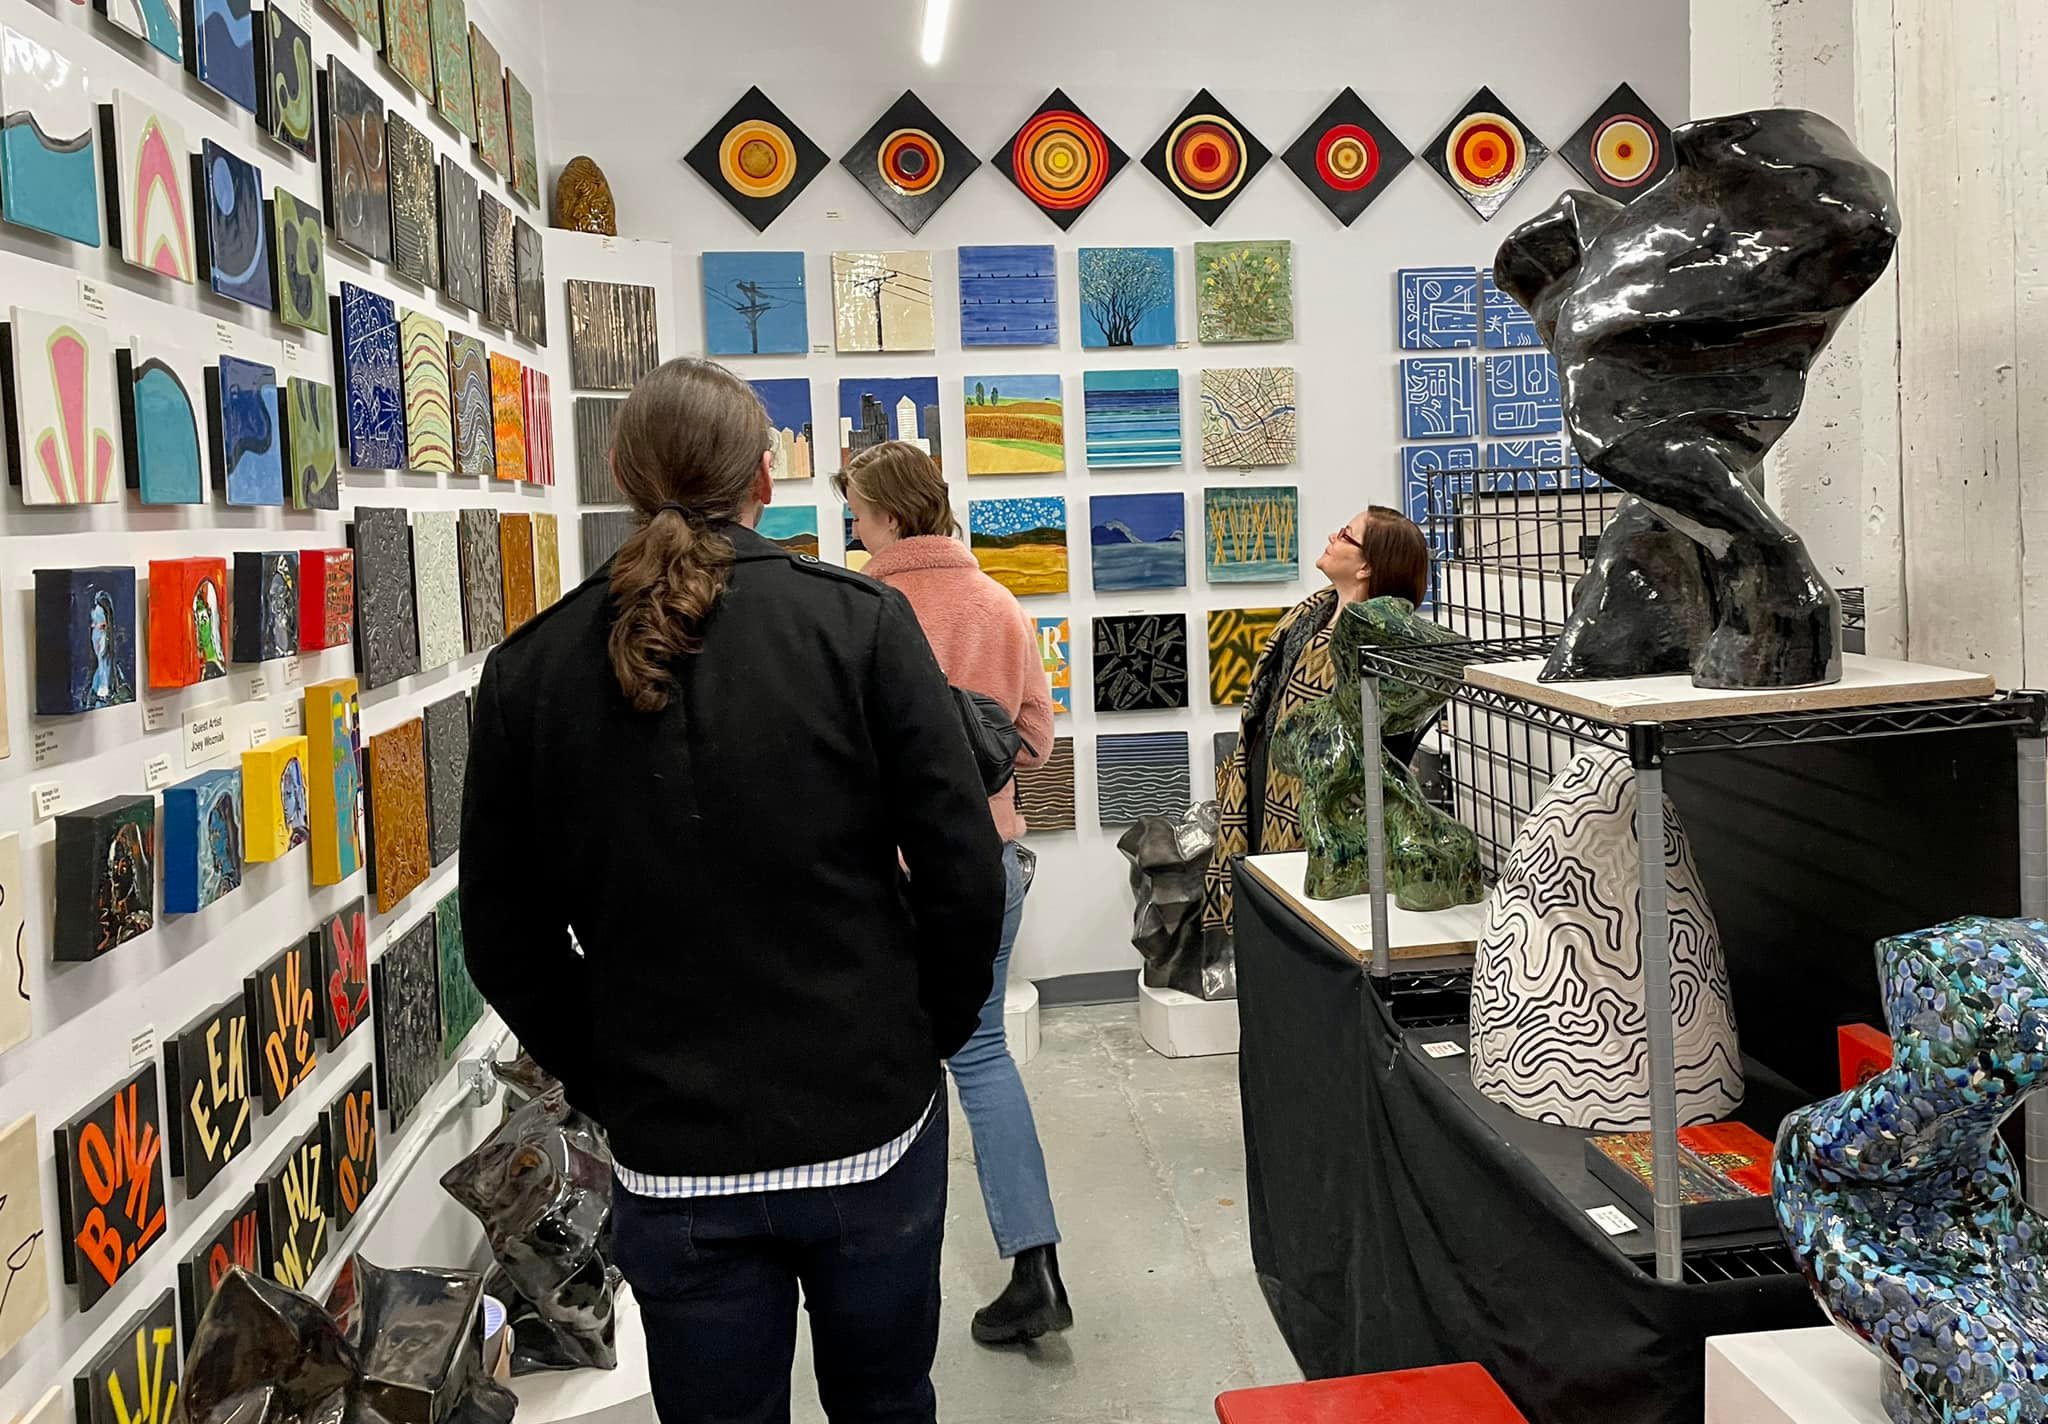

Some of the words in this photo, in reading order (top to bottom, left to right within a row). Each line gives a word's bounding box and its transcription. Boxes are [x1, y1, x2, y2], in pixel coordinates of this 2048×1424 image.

[191, 741, 203, 753] Joey
[192, 721, 208, 735] Guest
[209, 716, 222, 729] Artist
[265, 950, 317, 1101] DING!
[329, 911, 368, 1037] BAM!
[191, 1015, 249, 1162] EEK!
[76, 1083, 166, 1287] BONK!
[339, 1090, 375, 1214] OOF!
